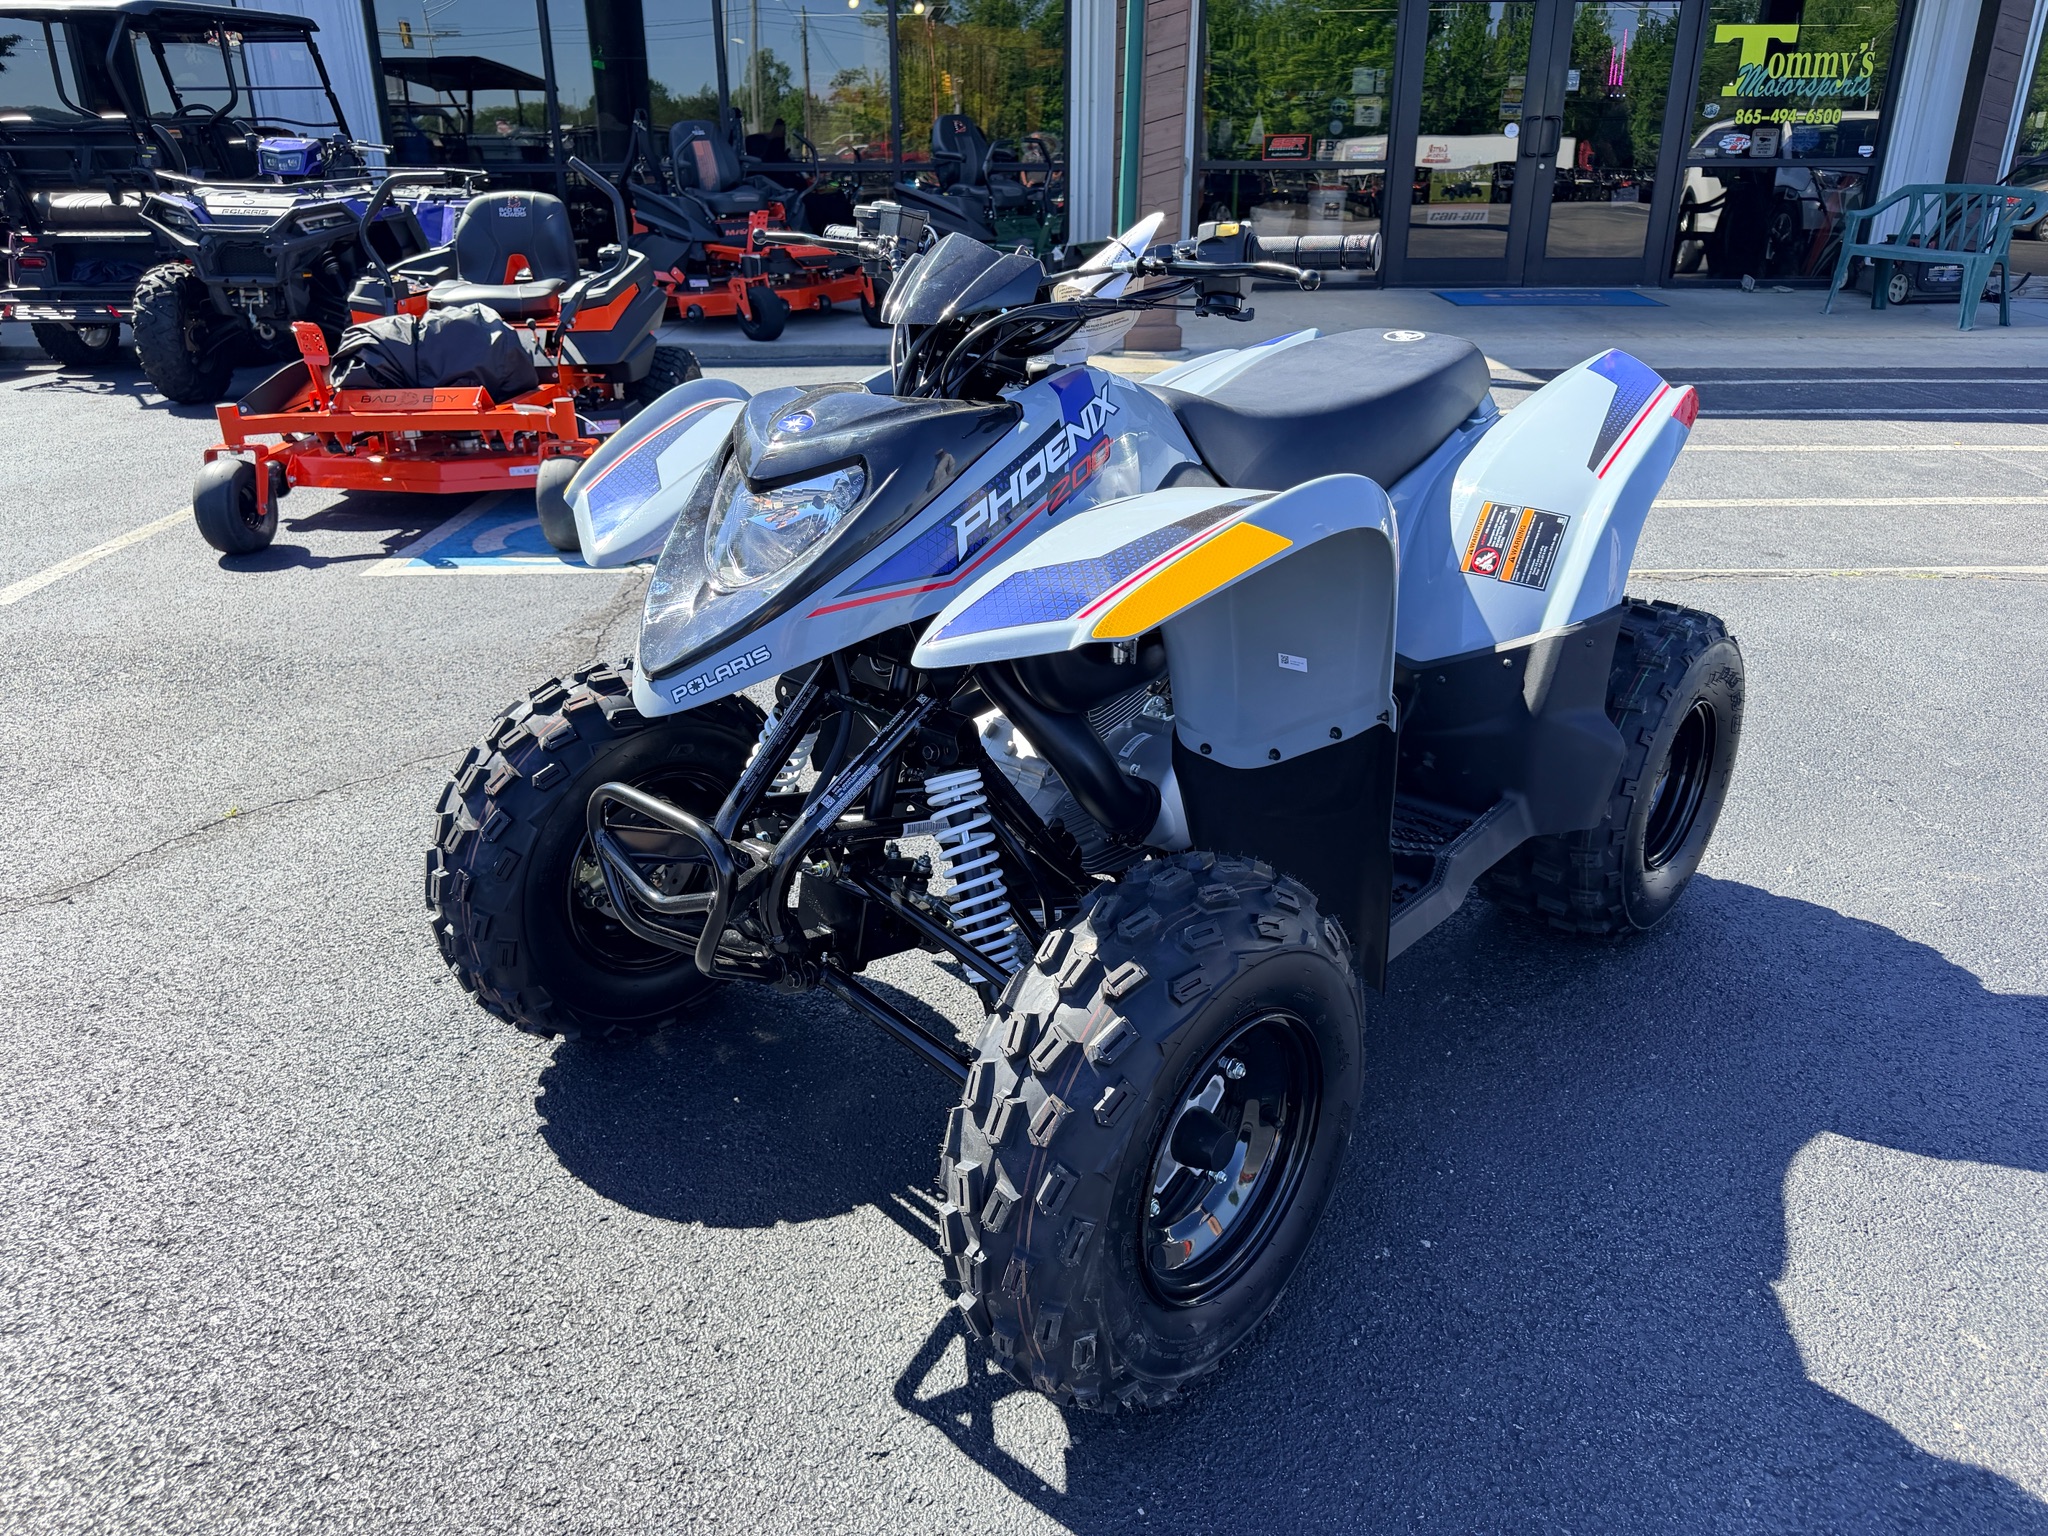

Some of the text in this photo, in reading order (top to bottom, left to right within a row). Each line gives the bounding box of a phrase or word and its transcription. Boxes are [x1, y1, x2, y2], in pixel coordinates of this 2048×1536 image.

[1714, 24, 1876, 97] Tommy's
[1738, 62, 1872, 106] Motorsports
[1735, 108, 1842, 125] 865-494-6500
[1429, 211, 1485, 221] can-am
[361, 394, 459, 403] BAD BOY
[951, 381, 1120, 562] PHOENIX
[1048, 435, 1111, 514] 200
[1470, 518, 1485, 549] WARNING
[1511, 524, 1526, 556] WARNING
[670, 645, 773, 705] POLARIS
